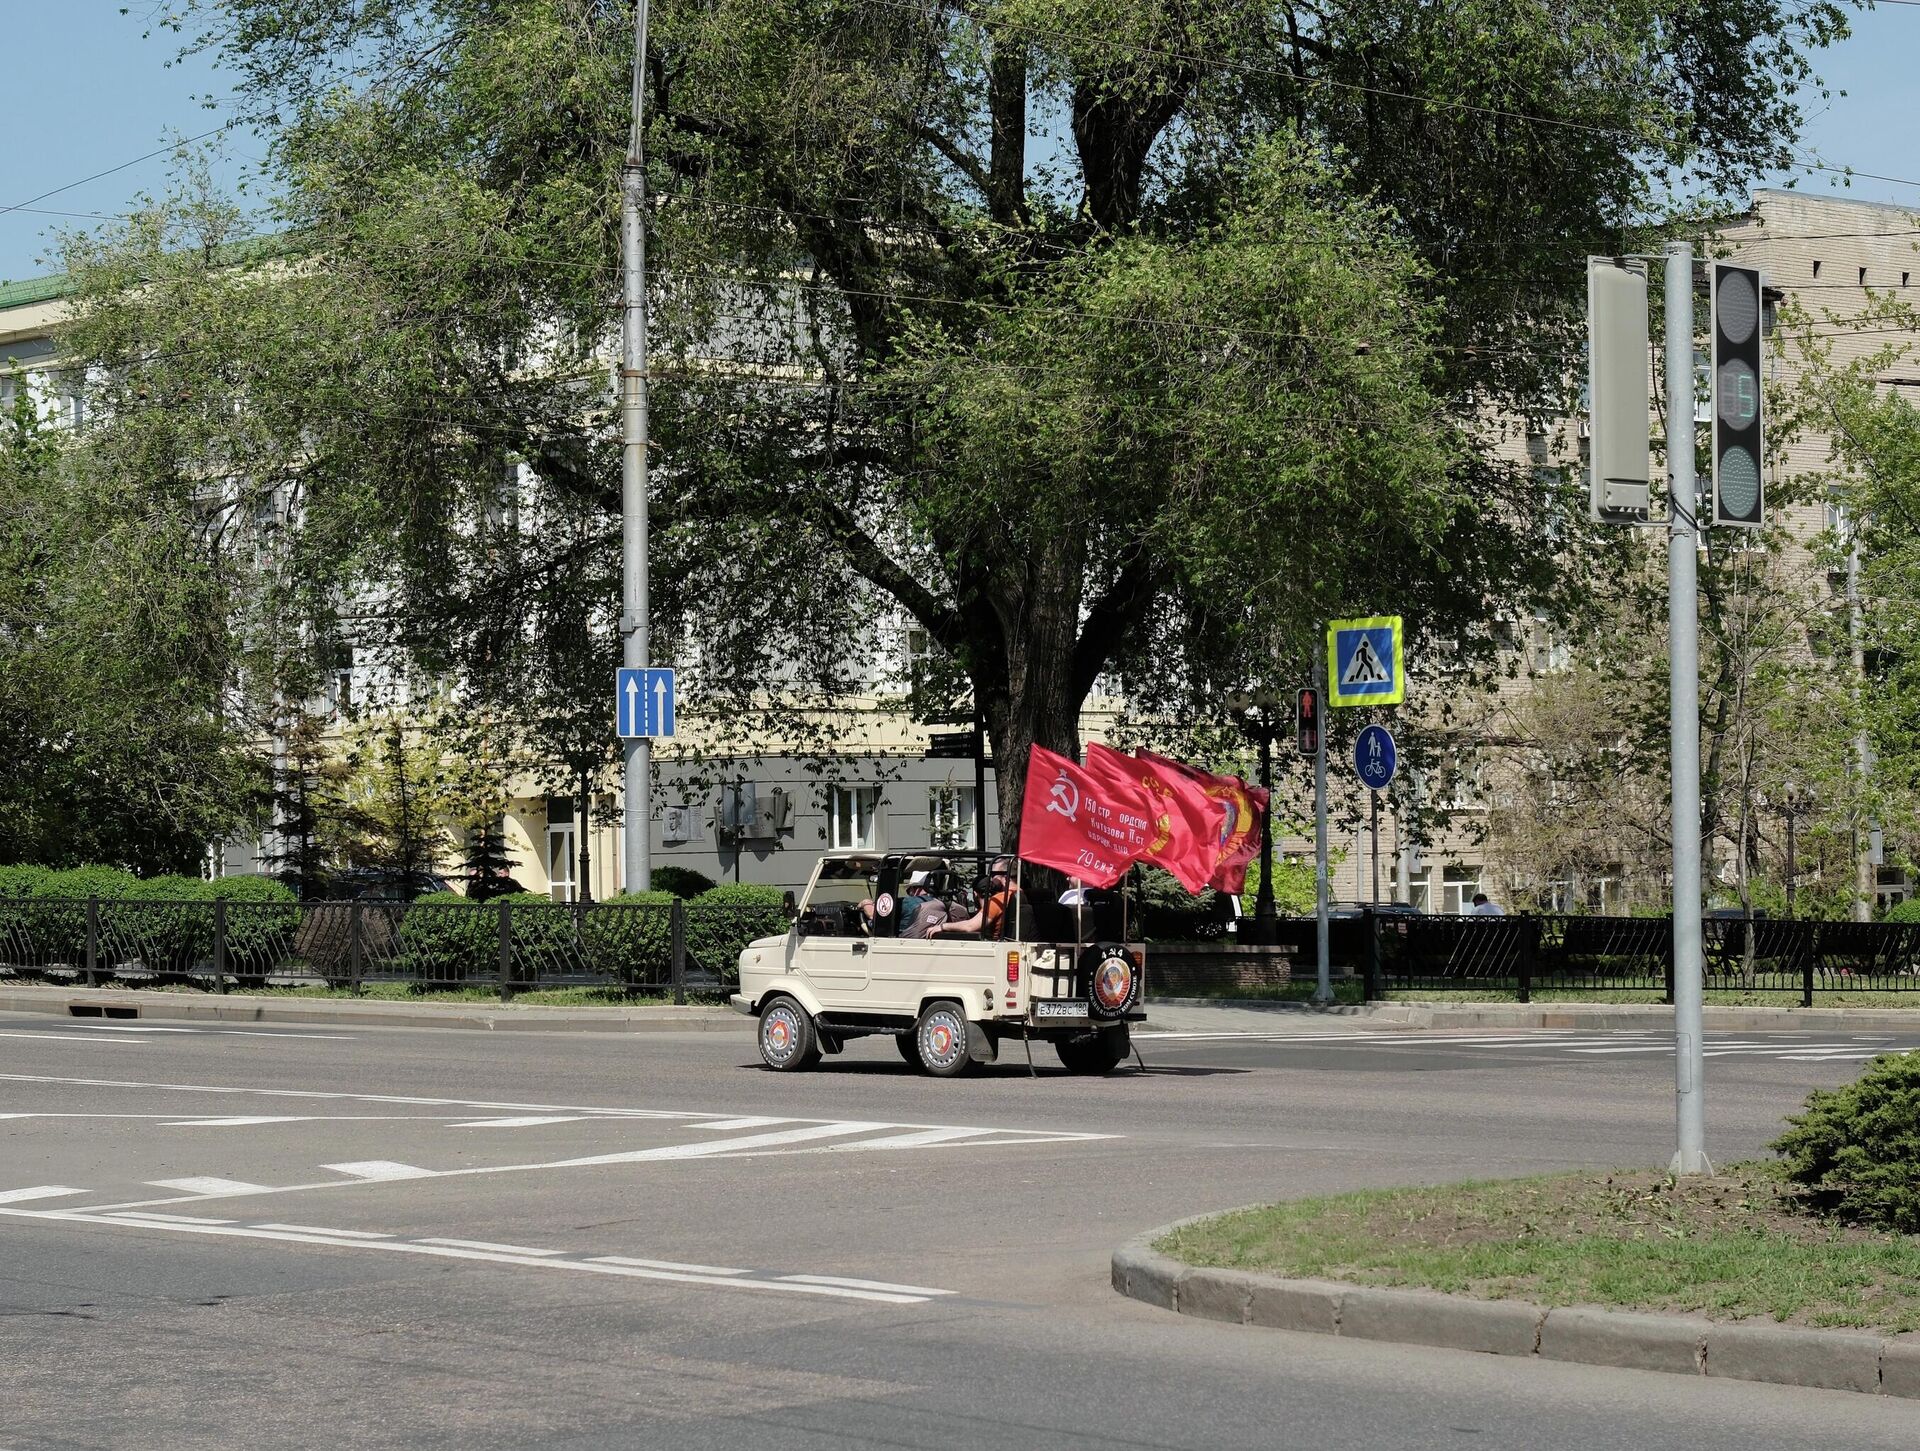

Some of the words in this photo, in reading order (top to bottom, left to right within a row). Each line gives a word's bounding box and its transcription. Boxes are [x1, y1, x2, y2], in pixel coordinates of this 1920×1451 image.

[1738, 375, 1754, 418] 5
[1085, 797, 1097, 813] 150
[1077, 849, 1094, 867] 79
